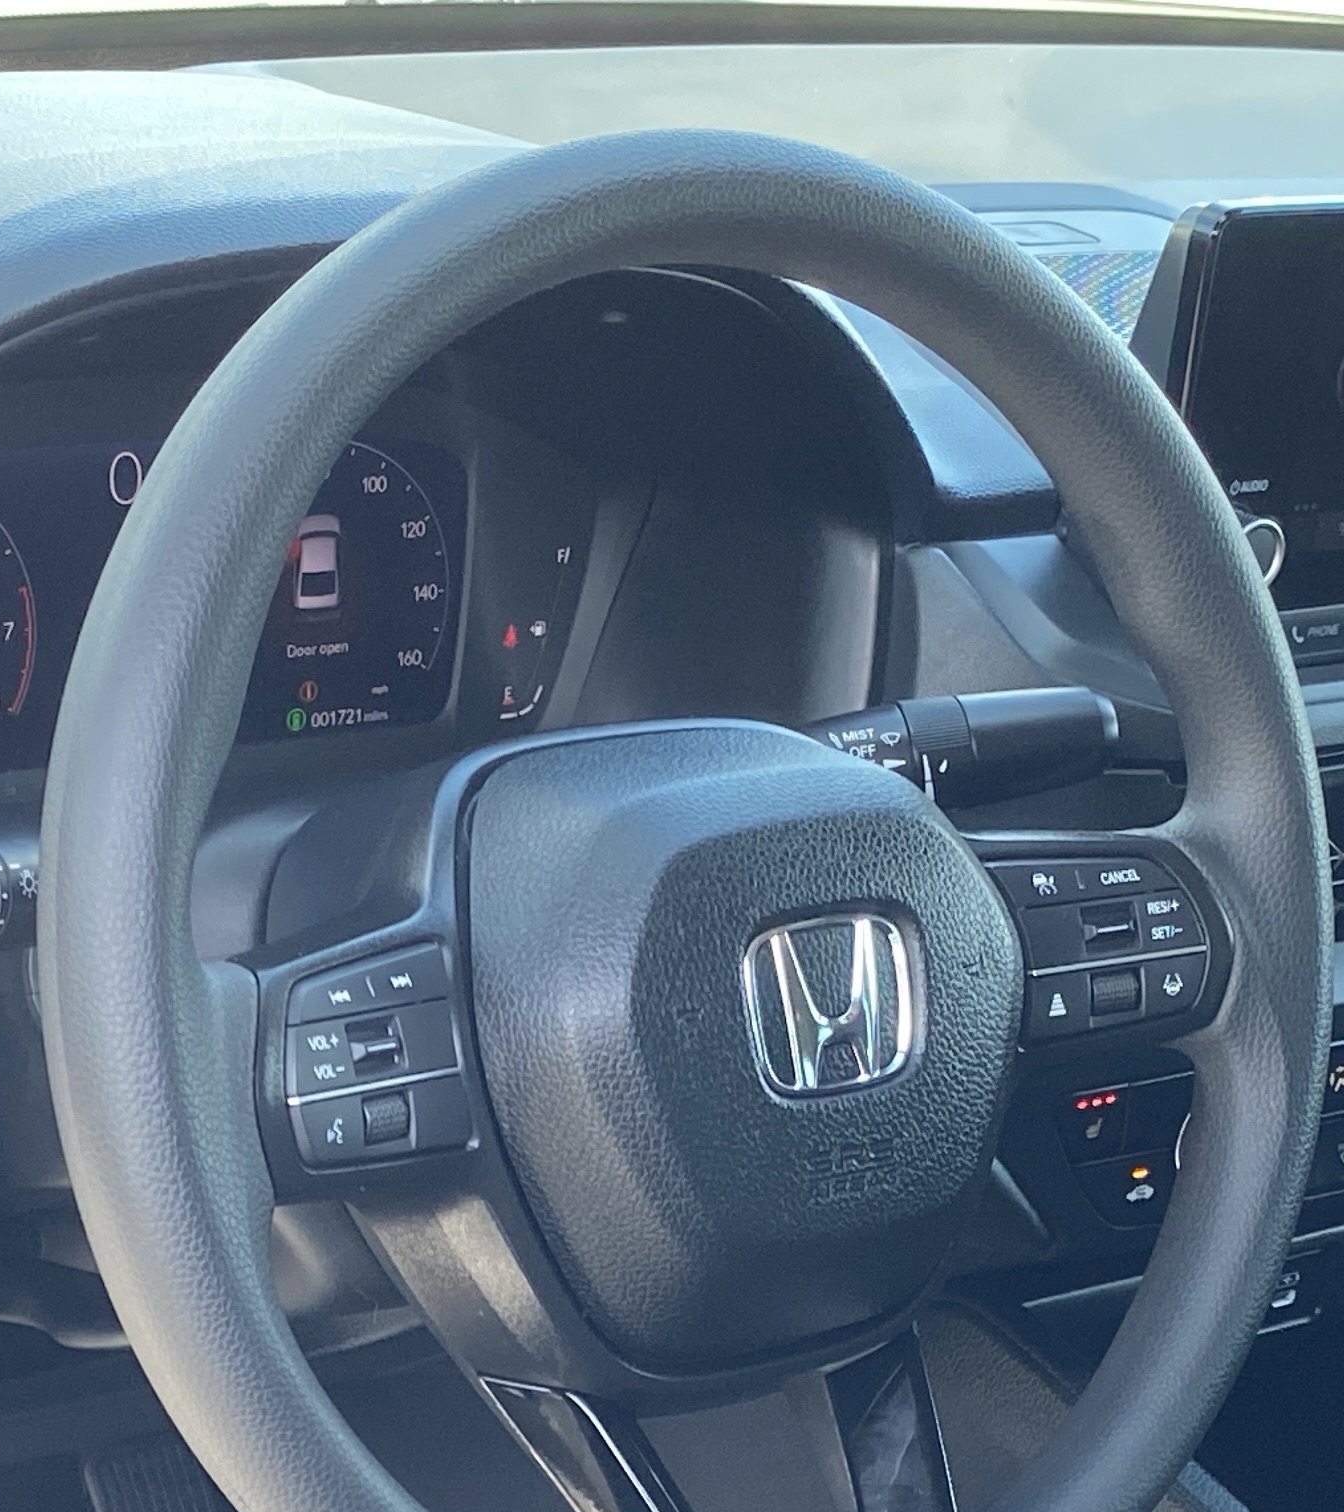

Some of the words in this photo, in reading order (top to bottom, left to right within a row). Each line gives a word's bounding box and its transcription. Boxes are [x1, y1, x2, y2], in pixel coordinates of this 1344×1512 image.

[109, 451, 142, 505] 0
[362, 476, 387, 493] 100
[401, 521, 425, 538] 120
[413, 584, 437, 601] 140
[3, 621, 15, 641] 7
[287, 643, 316, 658] Door
[318, 641, 348, 657] open
[397, 650, 421, 666] 160
[311, 709, 362, 728] 001721
[842, 728, 875, 743] MIST
[849, 743, 877, 760] OFF
[1099, 868, 1141, 886] CANCEL
